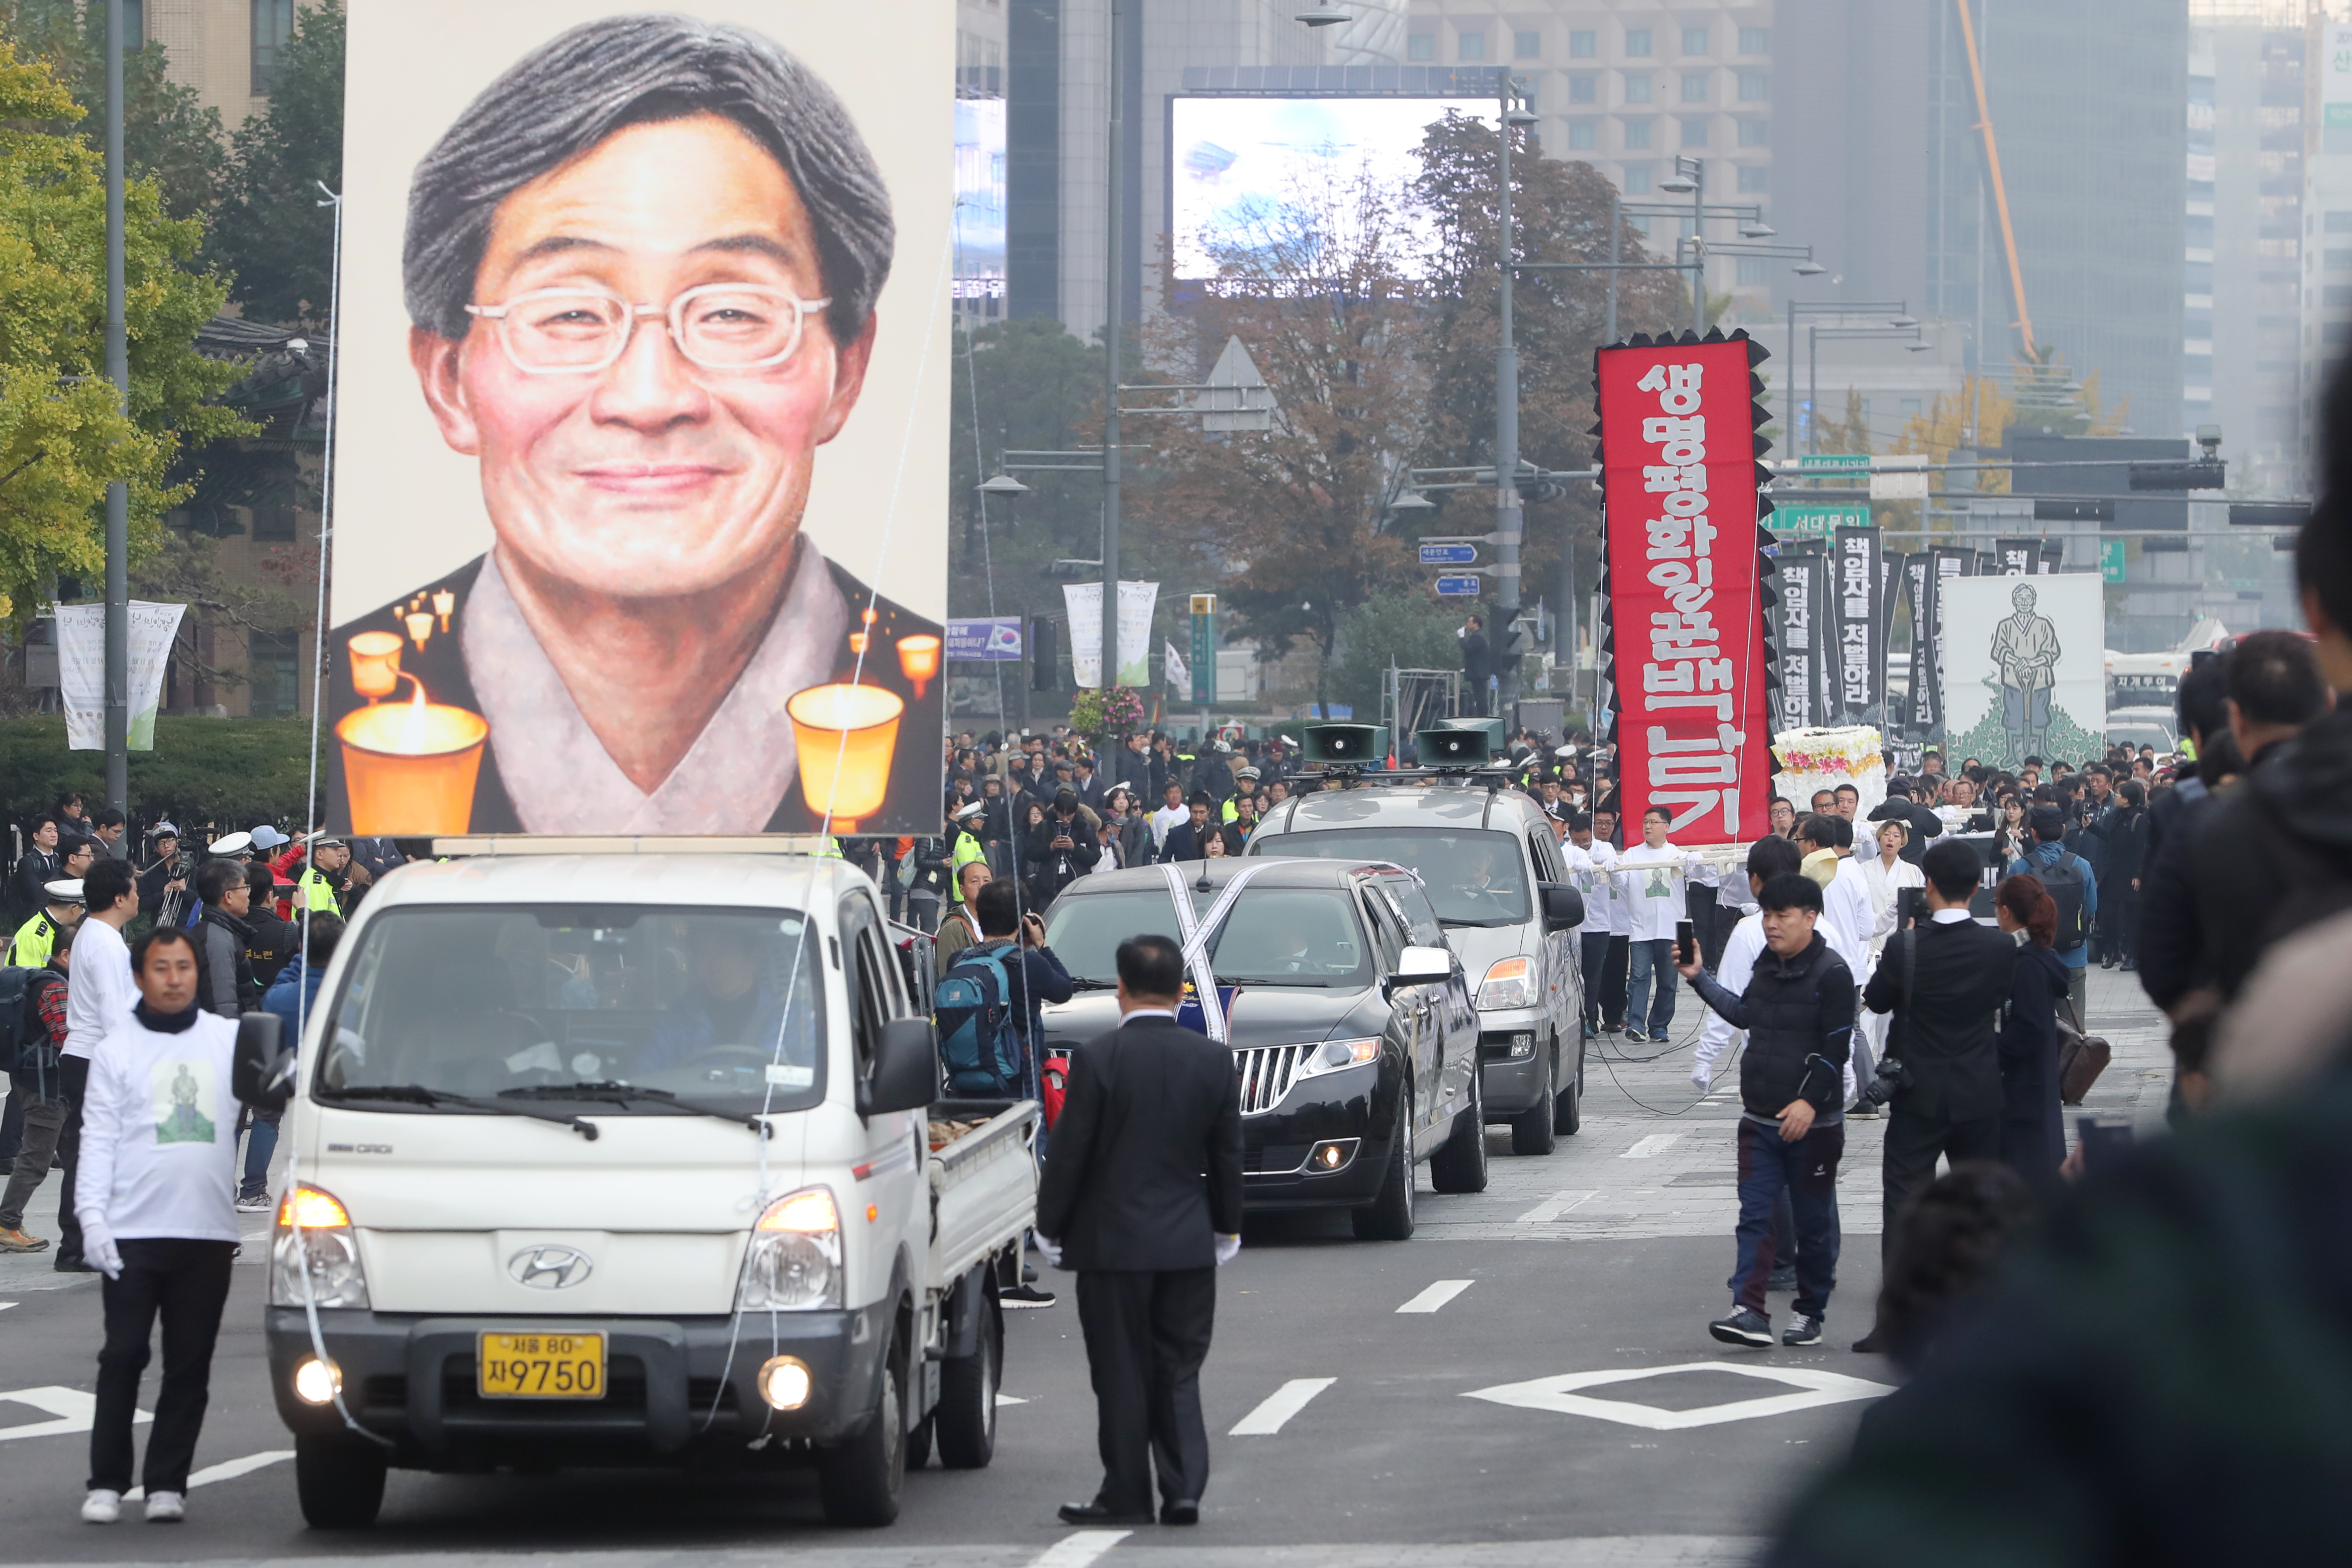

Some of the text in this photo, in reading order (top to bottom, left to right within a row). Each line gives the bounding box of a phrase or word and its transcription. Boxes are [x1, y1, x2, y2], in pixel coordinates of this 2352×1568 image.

[1782, 566, 1810, 649] 책임자를
[1843, 538, 1871, 704] 책임자를 처벌하라
[489, 1359, 595, 1390] 자9750
[512, 1338, 573, 1354] 서울 80
